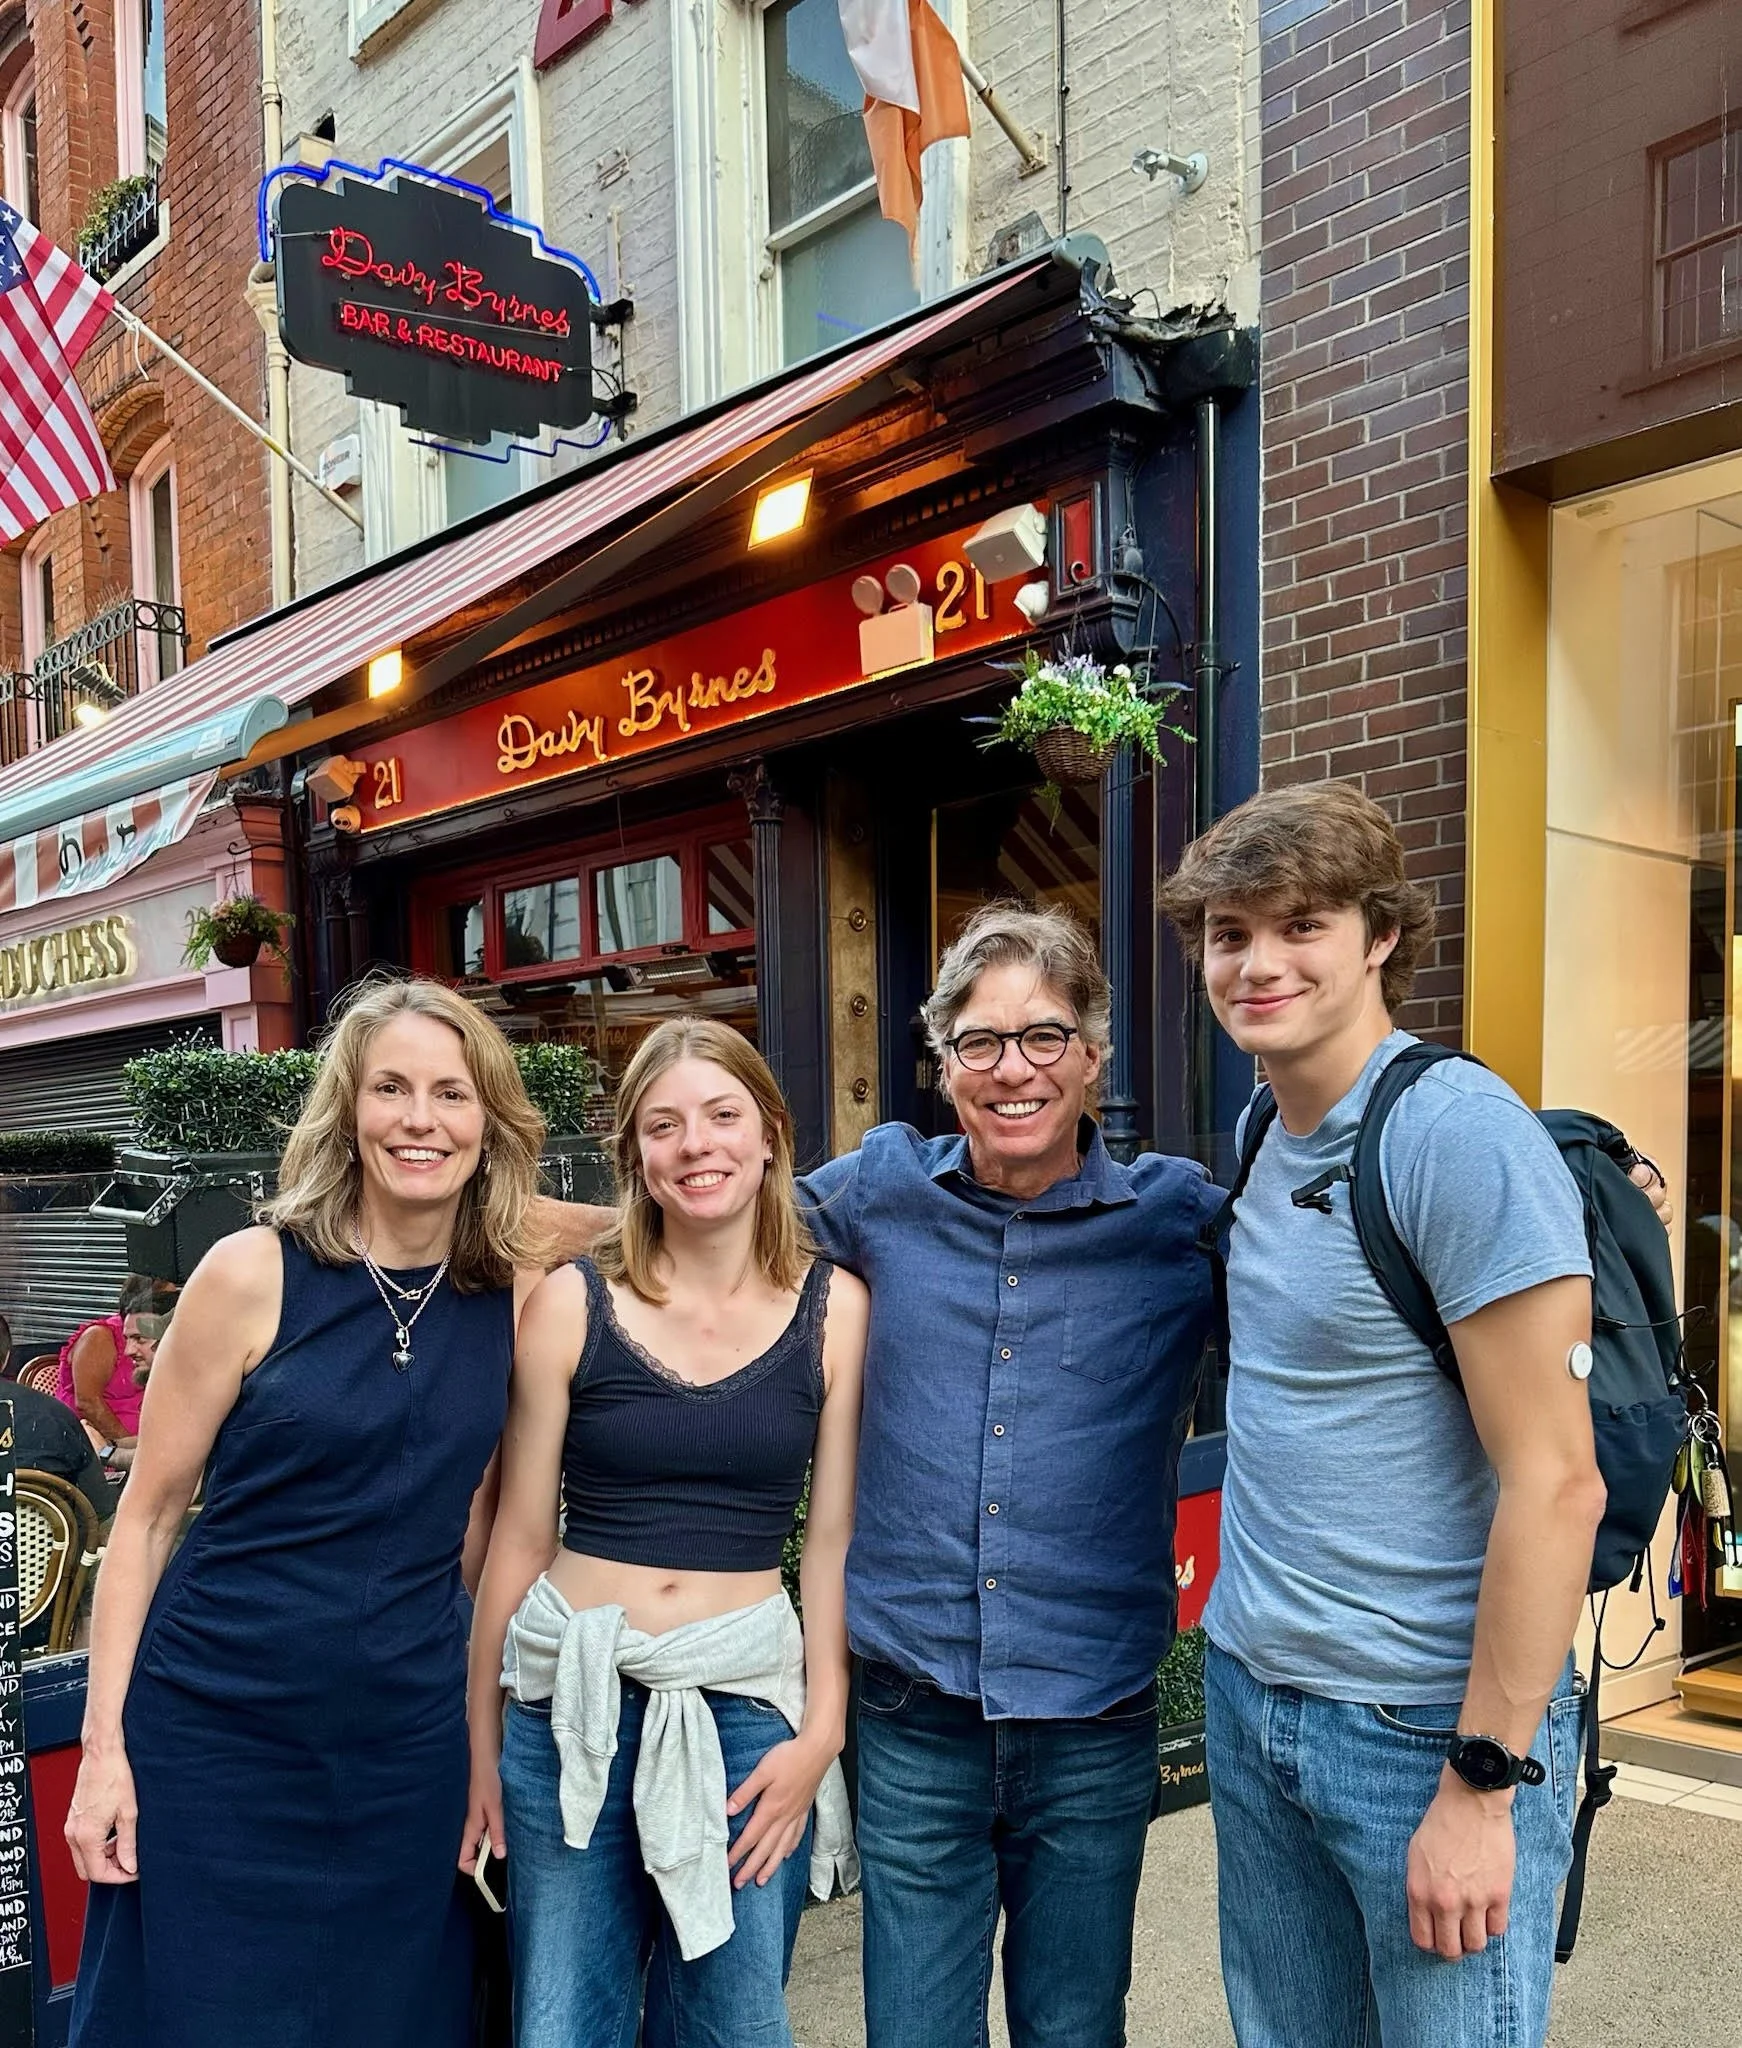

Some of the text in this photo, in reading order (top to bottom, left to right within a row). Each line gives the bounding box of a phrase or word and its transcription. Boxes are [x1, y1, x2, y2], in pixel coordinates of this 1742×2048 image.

[321, 226, 569, 331] Davy Byrnes
[342, 303, 563, 384] BAR & RESTAURANT
[936, 560, 989, 633] 21
[497, 648, 777, 774] Davy Byrnes
[373, 757, 402, 810] 21
[2, 915, 127, 999] DUCHESS
[1159, 1761, 1205, 1786] Byrnes
